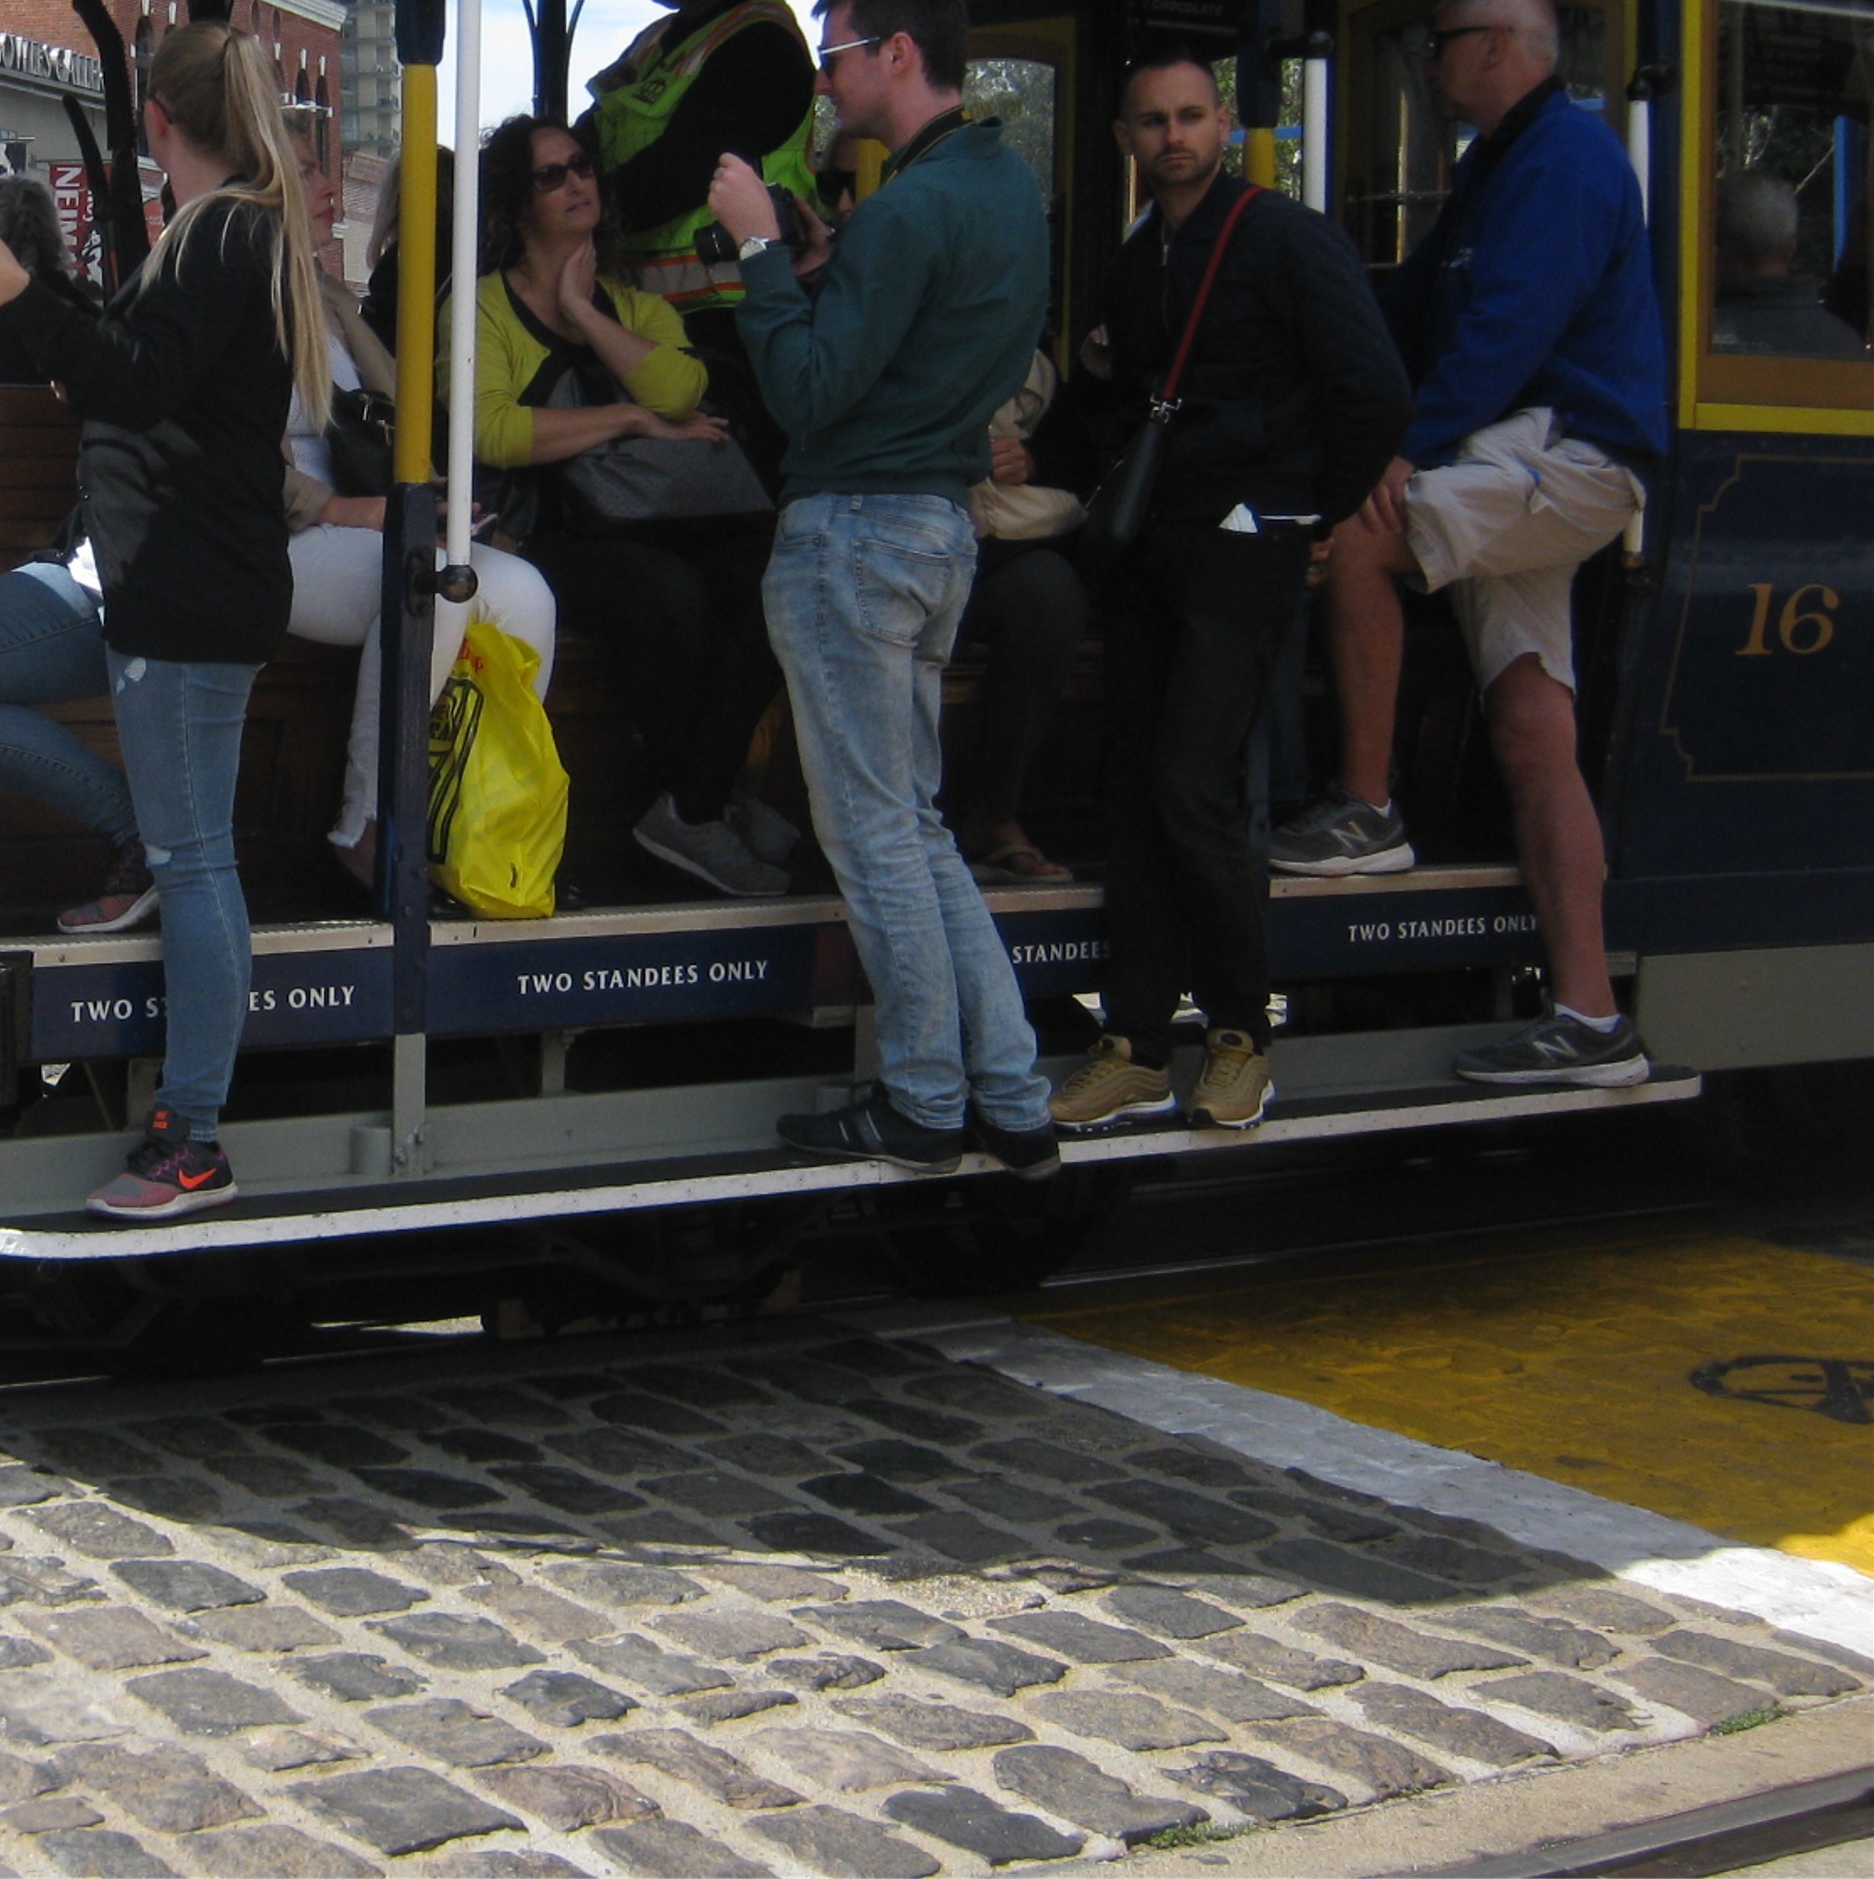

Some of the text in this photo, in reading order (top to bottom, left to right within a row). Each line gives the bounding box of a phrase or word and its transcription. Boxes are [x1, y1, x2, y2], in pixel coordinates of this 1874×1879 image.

[1736, 582, 1840, 658] 16
[1348, 914, 1538, 942] TWO STANDEES ONLY
[1011, 941, 1110, 964] STANDEES
[517, 958, 770, 997] TWO STANDEES ONLY
[70, 999, 134, 1023] TWO
[288, 985, 357, 1010] ONLY
